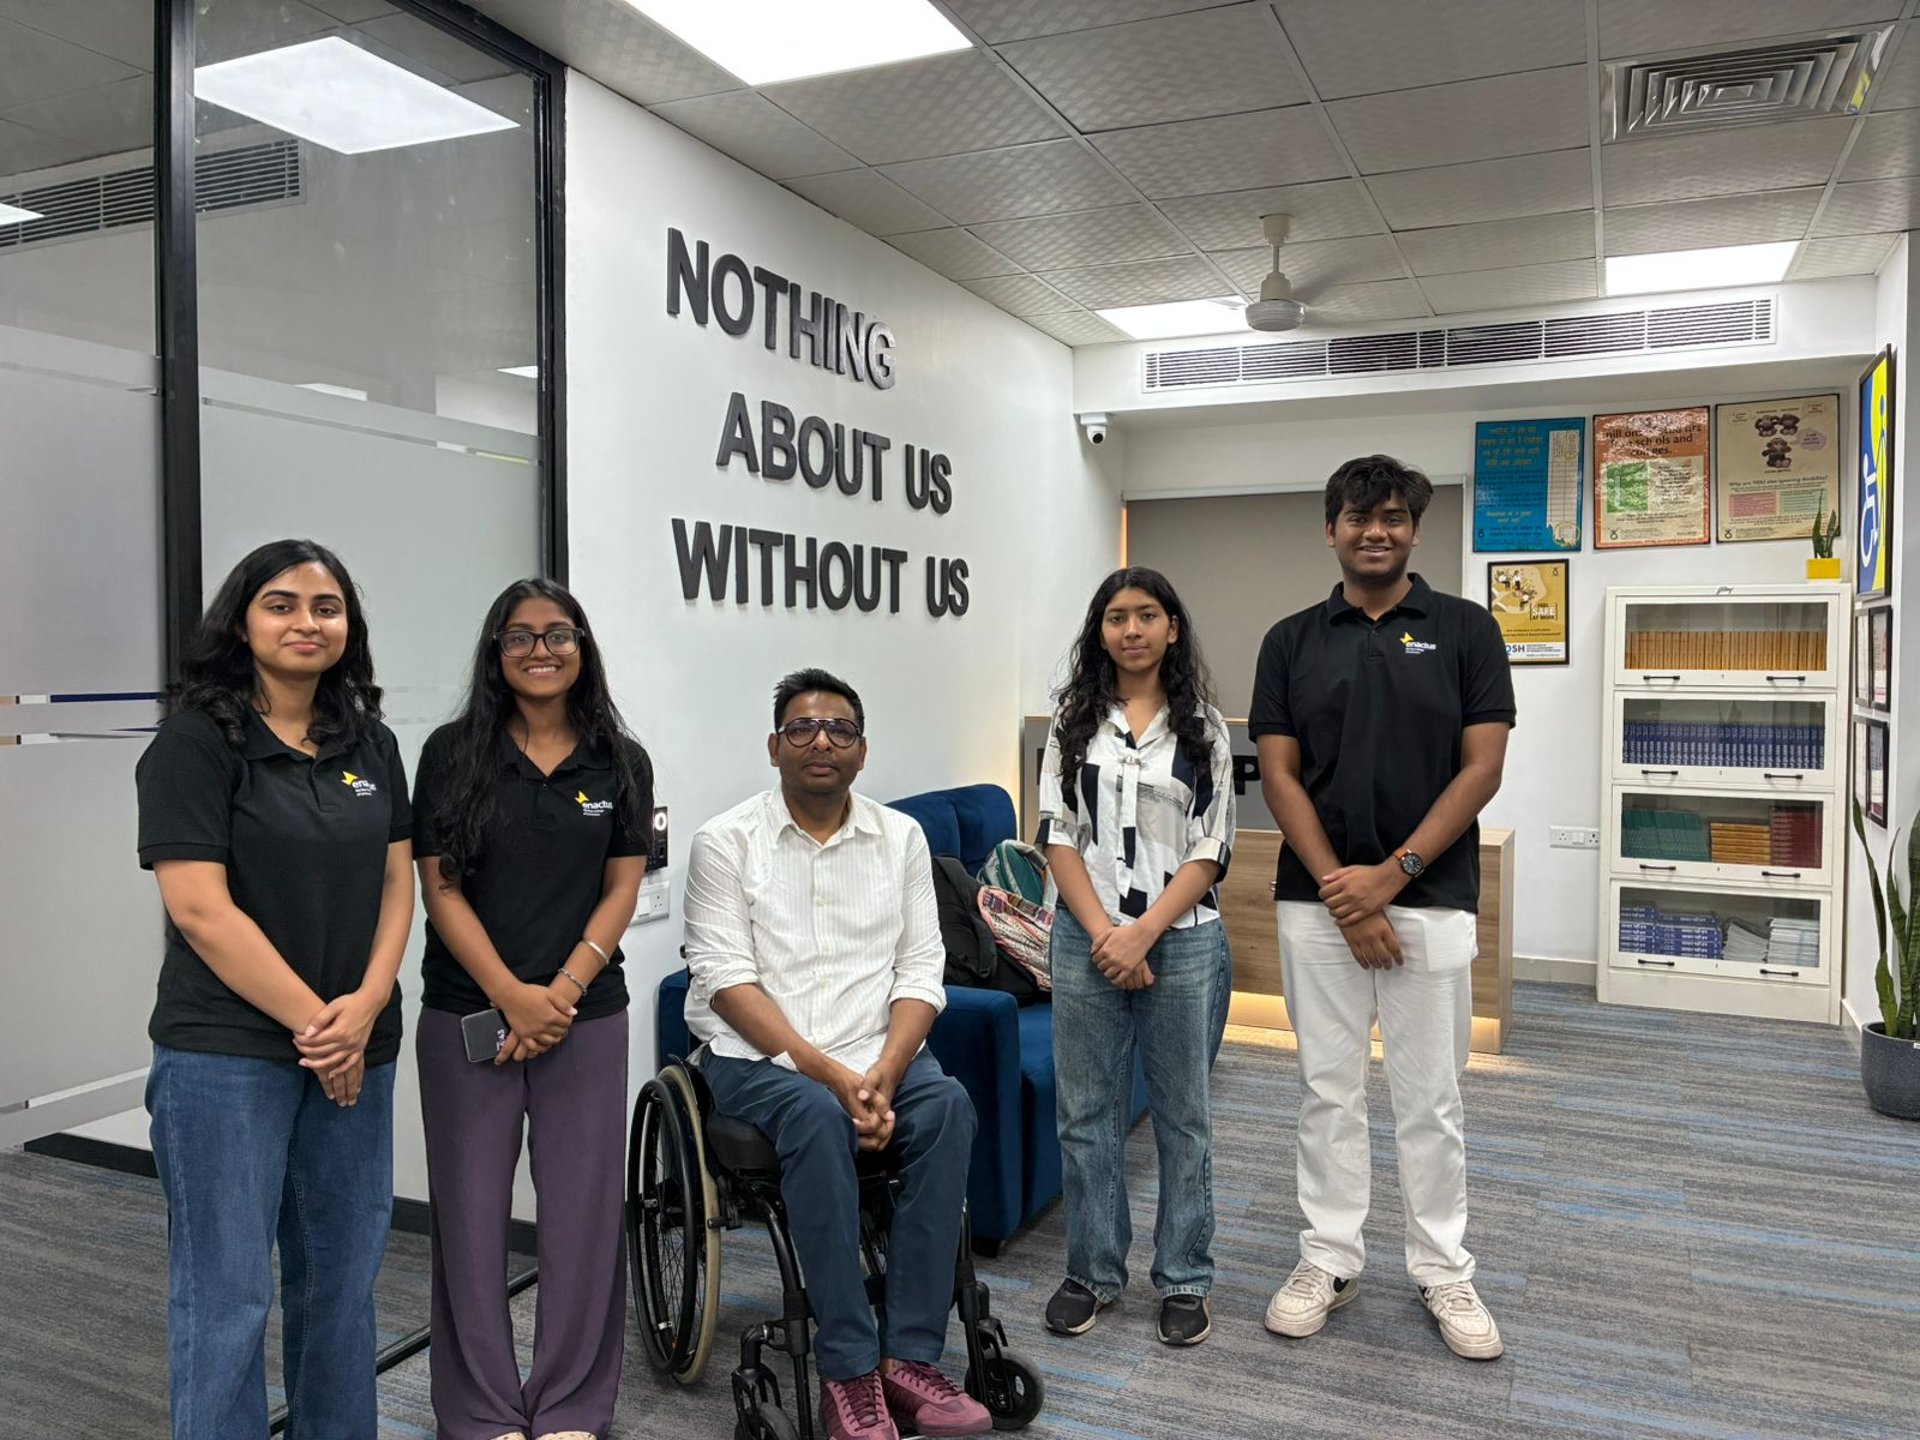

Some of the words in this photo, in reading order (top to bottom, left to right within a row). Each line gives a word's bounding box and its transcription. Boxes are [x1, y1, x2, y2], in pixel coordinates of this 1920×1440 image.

[667, 227, 896, 389] NOTHING
[716, 392, 890, 501] ABOUT
[905, 444, 952, 514] US
[1673, 434, 1693, 443] and
[672, 518, 907, 613] WITHOUT
[927, 556, 969, 618] US
[1532, 607, 1555, 616] SAFE
[1505, 644, 1525, 653] OSH
